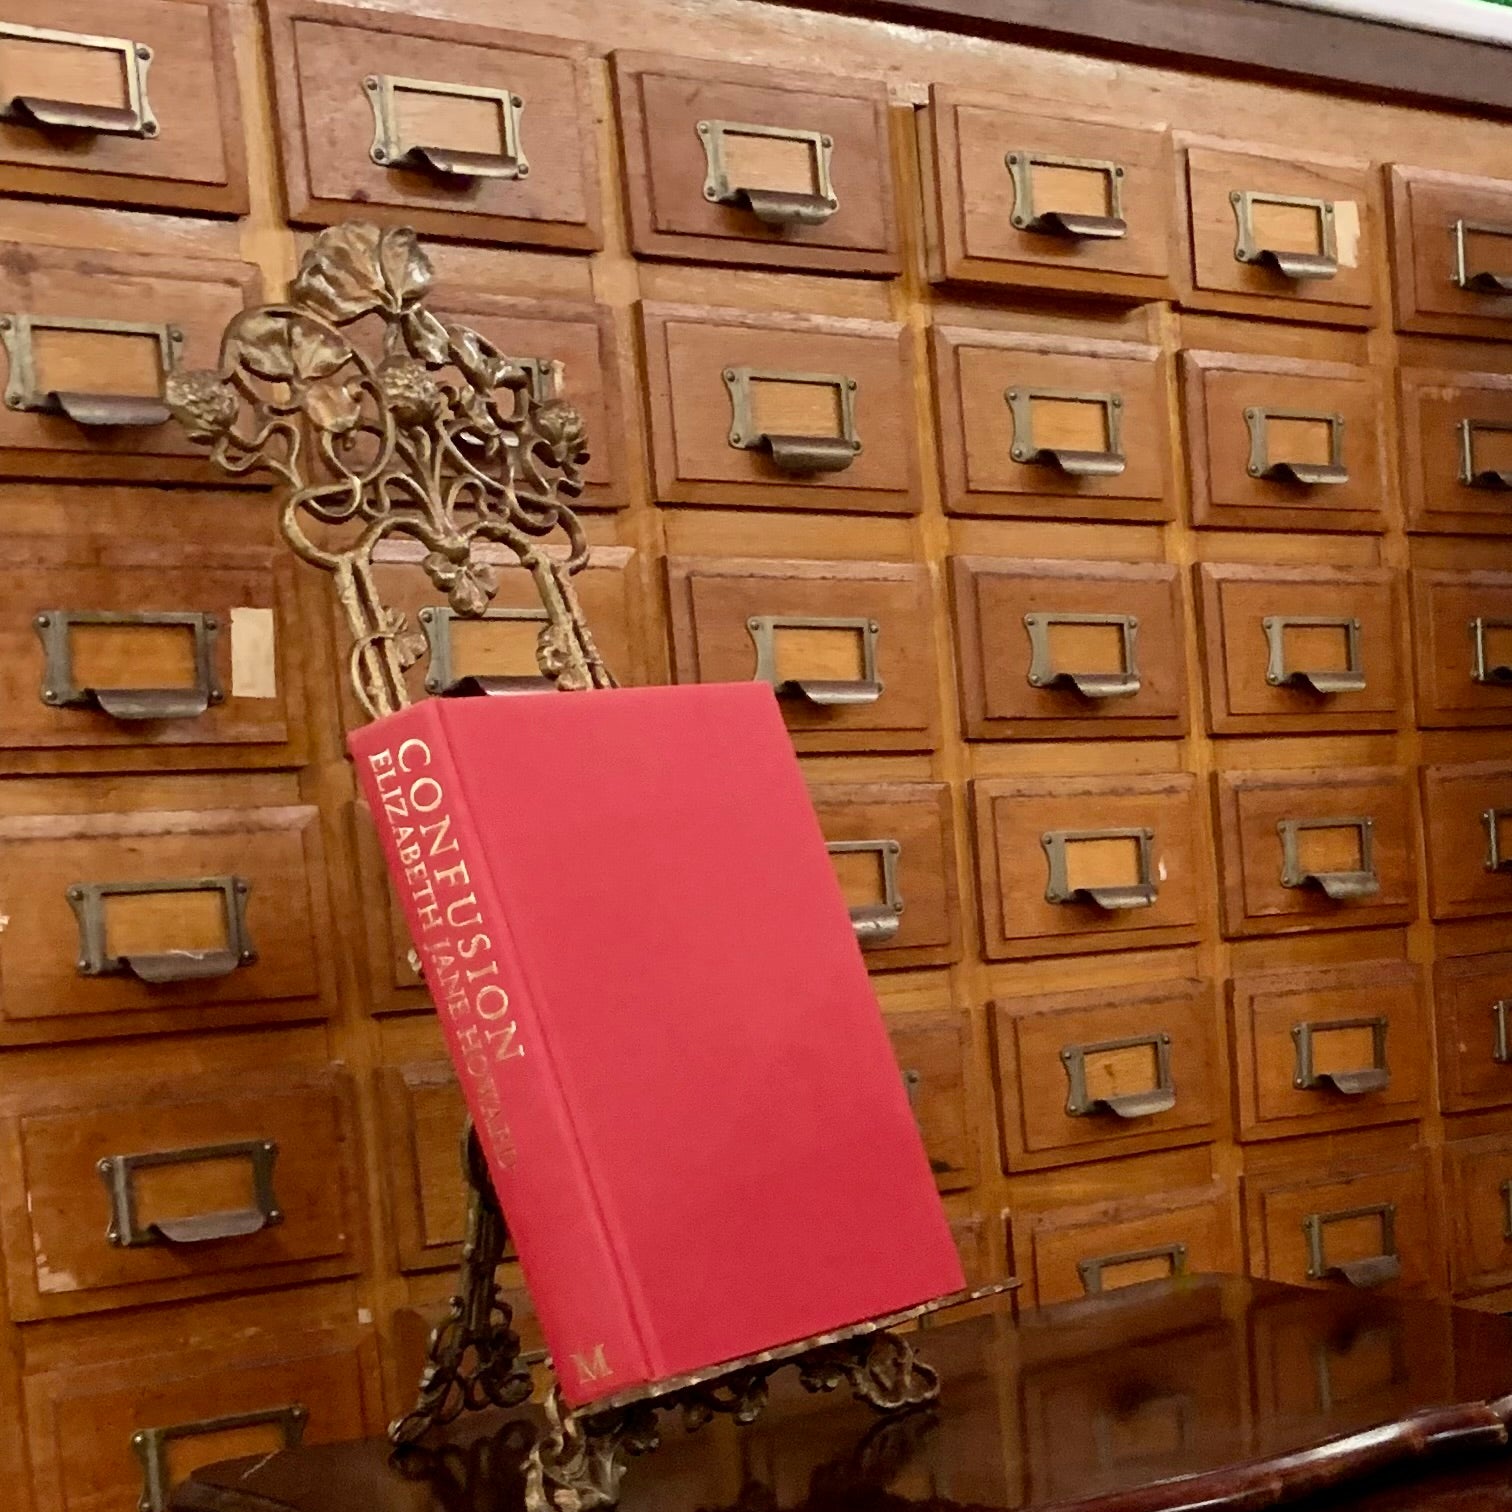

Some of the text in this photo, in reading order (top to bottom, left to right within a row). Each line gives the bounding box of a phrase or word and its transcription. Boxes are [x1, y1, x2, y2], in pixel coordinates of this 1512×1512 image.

[369, 749, 443, 932] ELIZABETH
[423, 938, 471, 1021] JANE
[398, 738, 525, 1061] CONFUSION
[570, 1344, 613, 1385] M
